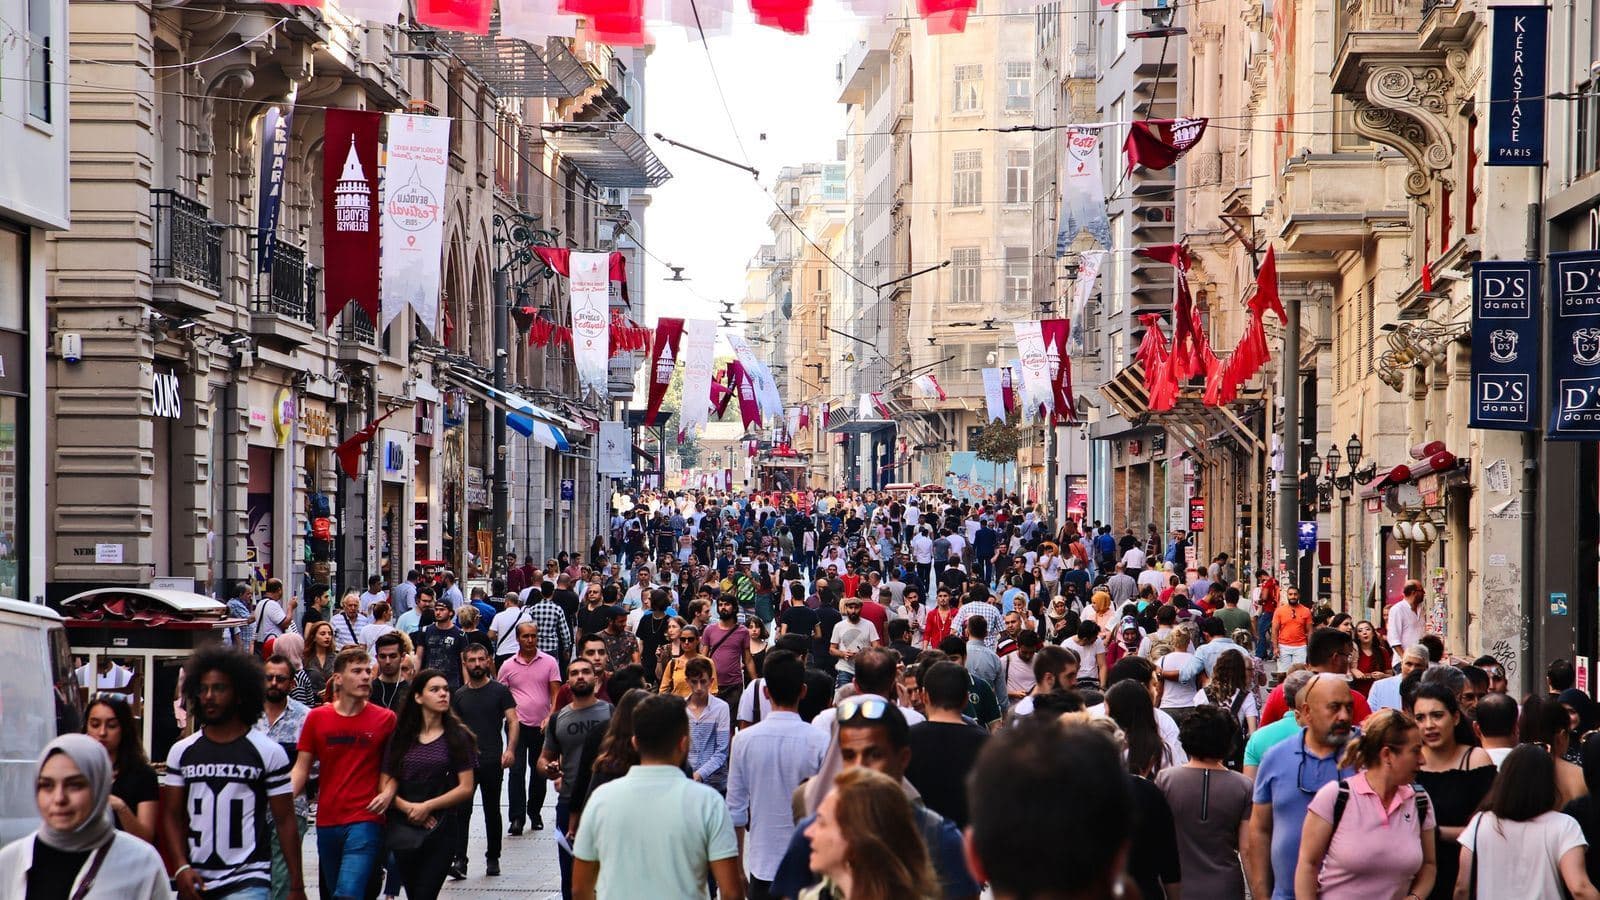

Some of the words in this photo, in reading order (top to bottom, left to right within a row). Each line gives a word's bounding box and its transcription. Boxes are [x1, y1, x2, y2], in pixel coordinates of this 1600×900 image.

[1511, 16, 1526, 142] KÉRASTASE
[1499, 148, 1531, 157] PARIS
[1484, 277, 1525, 298] D'S
[1565, 268, 1600, 293] D'
[1484, 301, 1525, 309] damat
[1581, 343, 1596, 351] D'S
[1482, 381, 1523, 401] D'S
[1565, 386, 1600, 409] D'
[1482, 404, 1524, 412] damat
[187, 781, 256, 866] 90
